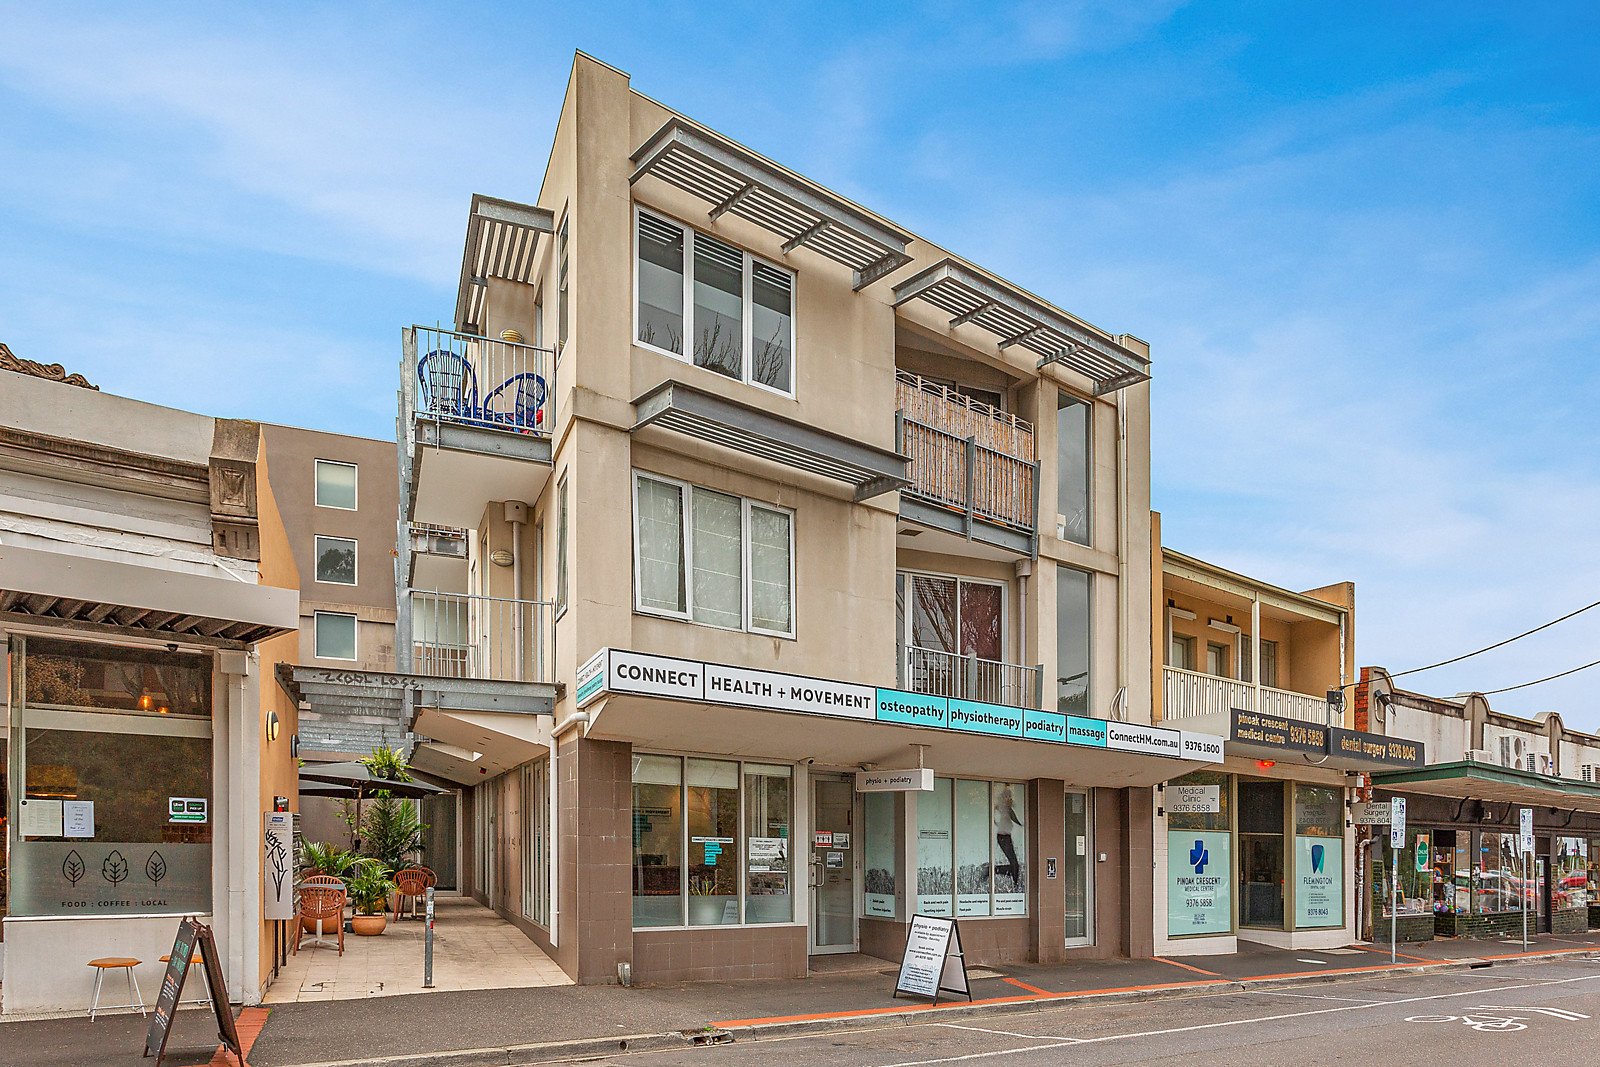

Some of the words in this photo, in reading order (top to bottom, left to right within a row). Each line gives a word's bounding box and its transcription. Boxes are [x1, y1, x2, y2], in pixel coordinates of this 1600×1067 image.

[617, 663, 698, 688] CONNECT
[711, 676, 772, 697] HEALTH
[790, 686, 871, 709] MOVEMENT
[880, 701, 944, 721] osteopathy
[951, 709, 1021, 730] physiotherapy
[1026, 719, 1064, 736] podiatry
[1238, 712, 1260, 726] pinoak
[1261, 718, 1289, 731] crescent
[1069, 727, 1105, 741] massage
[1109, 729, 1178, 749] ConnectHM.com.au
[1237, 728, 1264, 741] medical
[1265, 732, 1286, 744] centre
[1290, 726, 1307, 744] 9376
[1307, 729, 1324, 747] 5858
[1184, 740, 1202, 752] 9376
[1203, 744, 1220, 754] 1600
[1341, 735, 1361, 752] dental
[1363, 742, 1386, 759] surgery
[1388, 742, 1402, 759] 9376
[1402, 745, 1416, 761] 8043
[865, 777, 881, 785] physio
[890, 776, 912, 784] podiatry
[1178, 787, 1206, 795] Medical
[1176, 877, 1195, 885] PINOAK
[1196, 877, 1221, 885] CRESCENT
[1303, 876, 1333, 885] FLEMINGTON
[1186, 898, 1200, 907] 9376
[1200, 898, 1213, 907] 5858
[1307, 908, 1318, 916] 9376
[931, 925, 949, 933] podiatry
